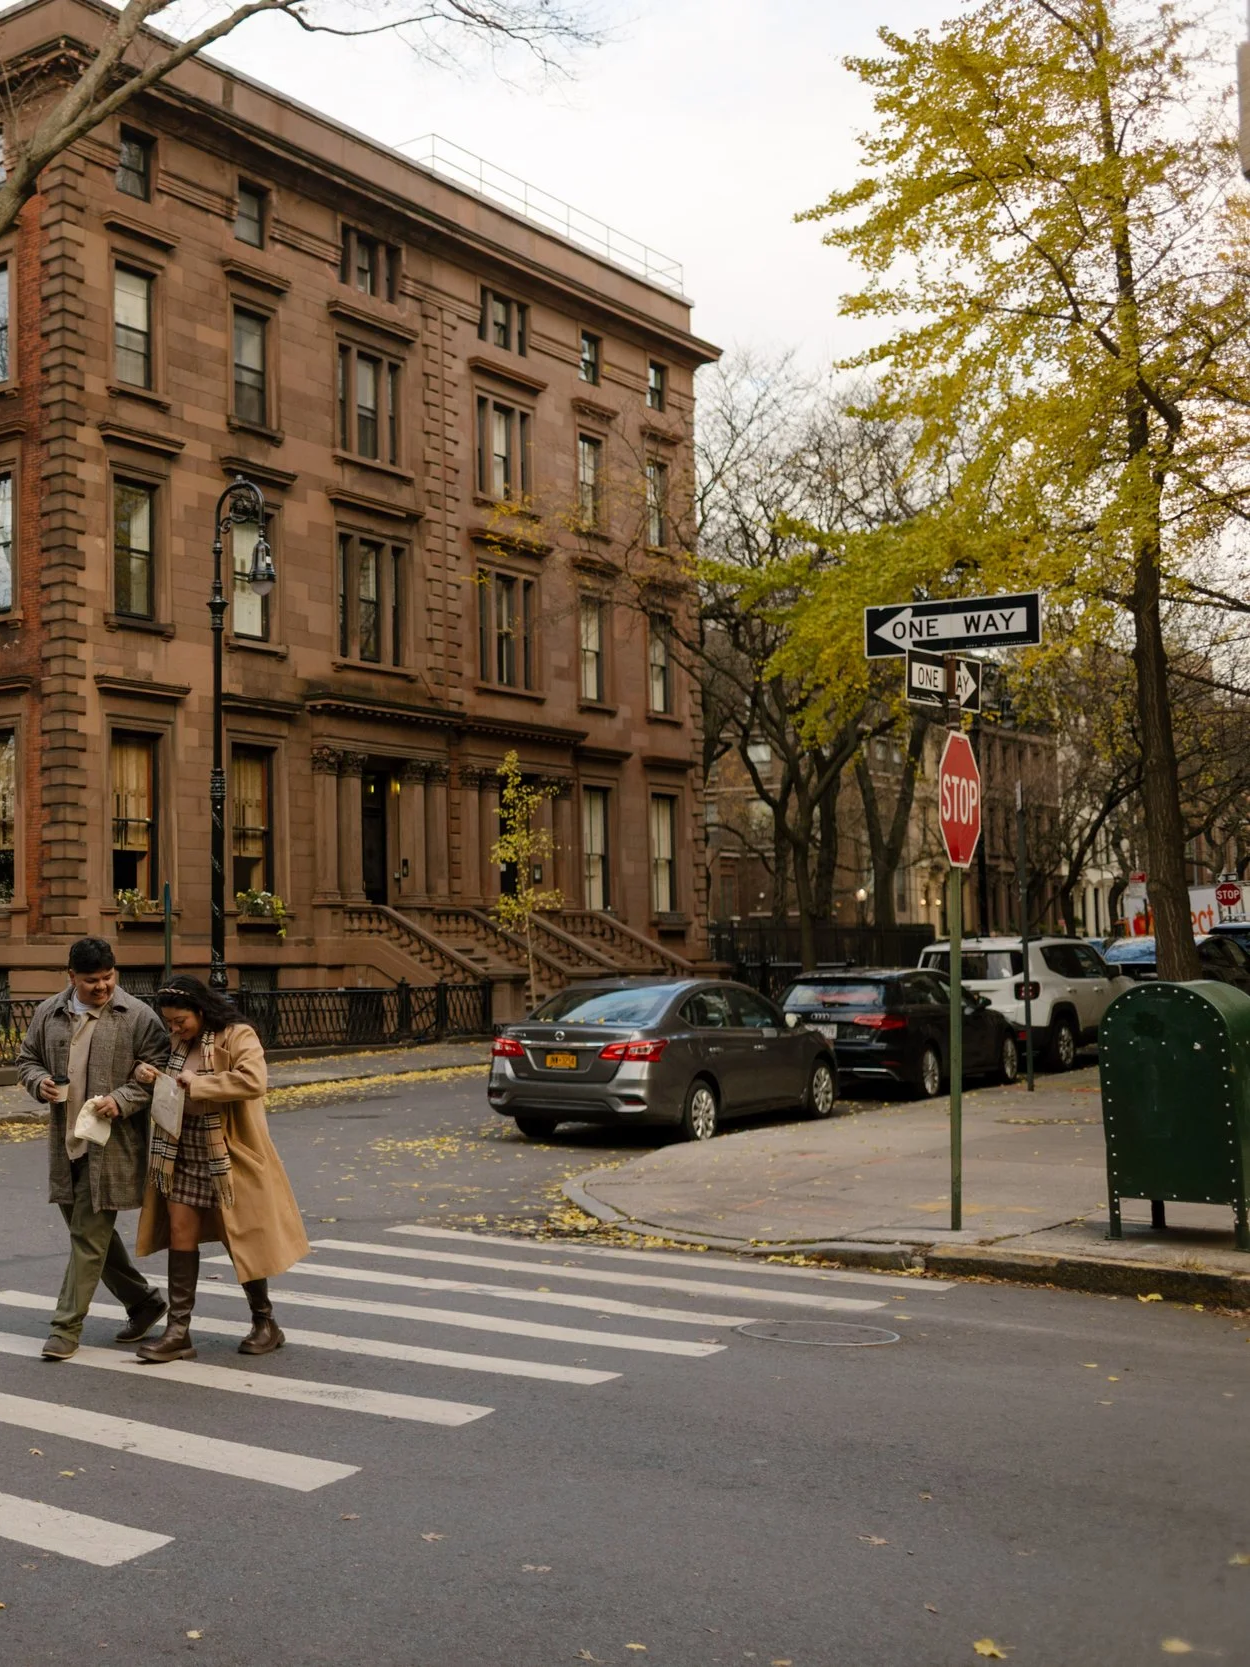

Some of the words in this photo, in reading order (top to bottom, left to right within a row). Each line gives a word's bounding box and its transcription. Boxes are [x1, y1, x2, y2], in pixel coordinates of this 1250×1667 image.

[892, 618, 939, 640] ONE
[963, 611, 1015, 634] WAY
[917, 667, 939, 689] ONE
[956, 672, 970, 694] AY
[942, 773, 978, 825] STOP
[1216, 890, 1240, 900] STOP
